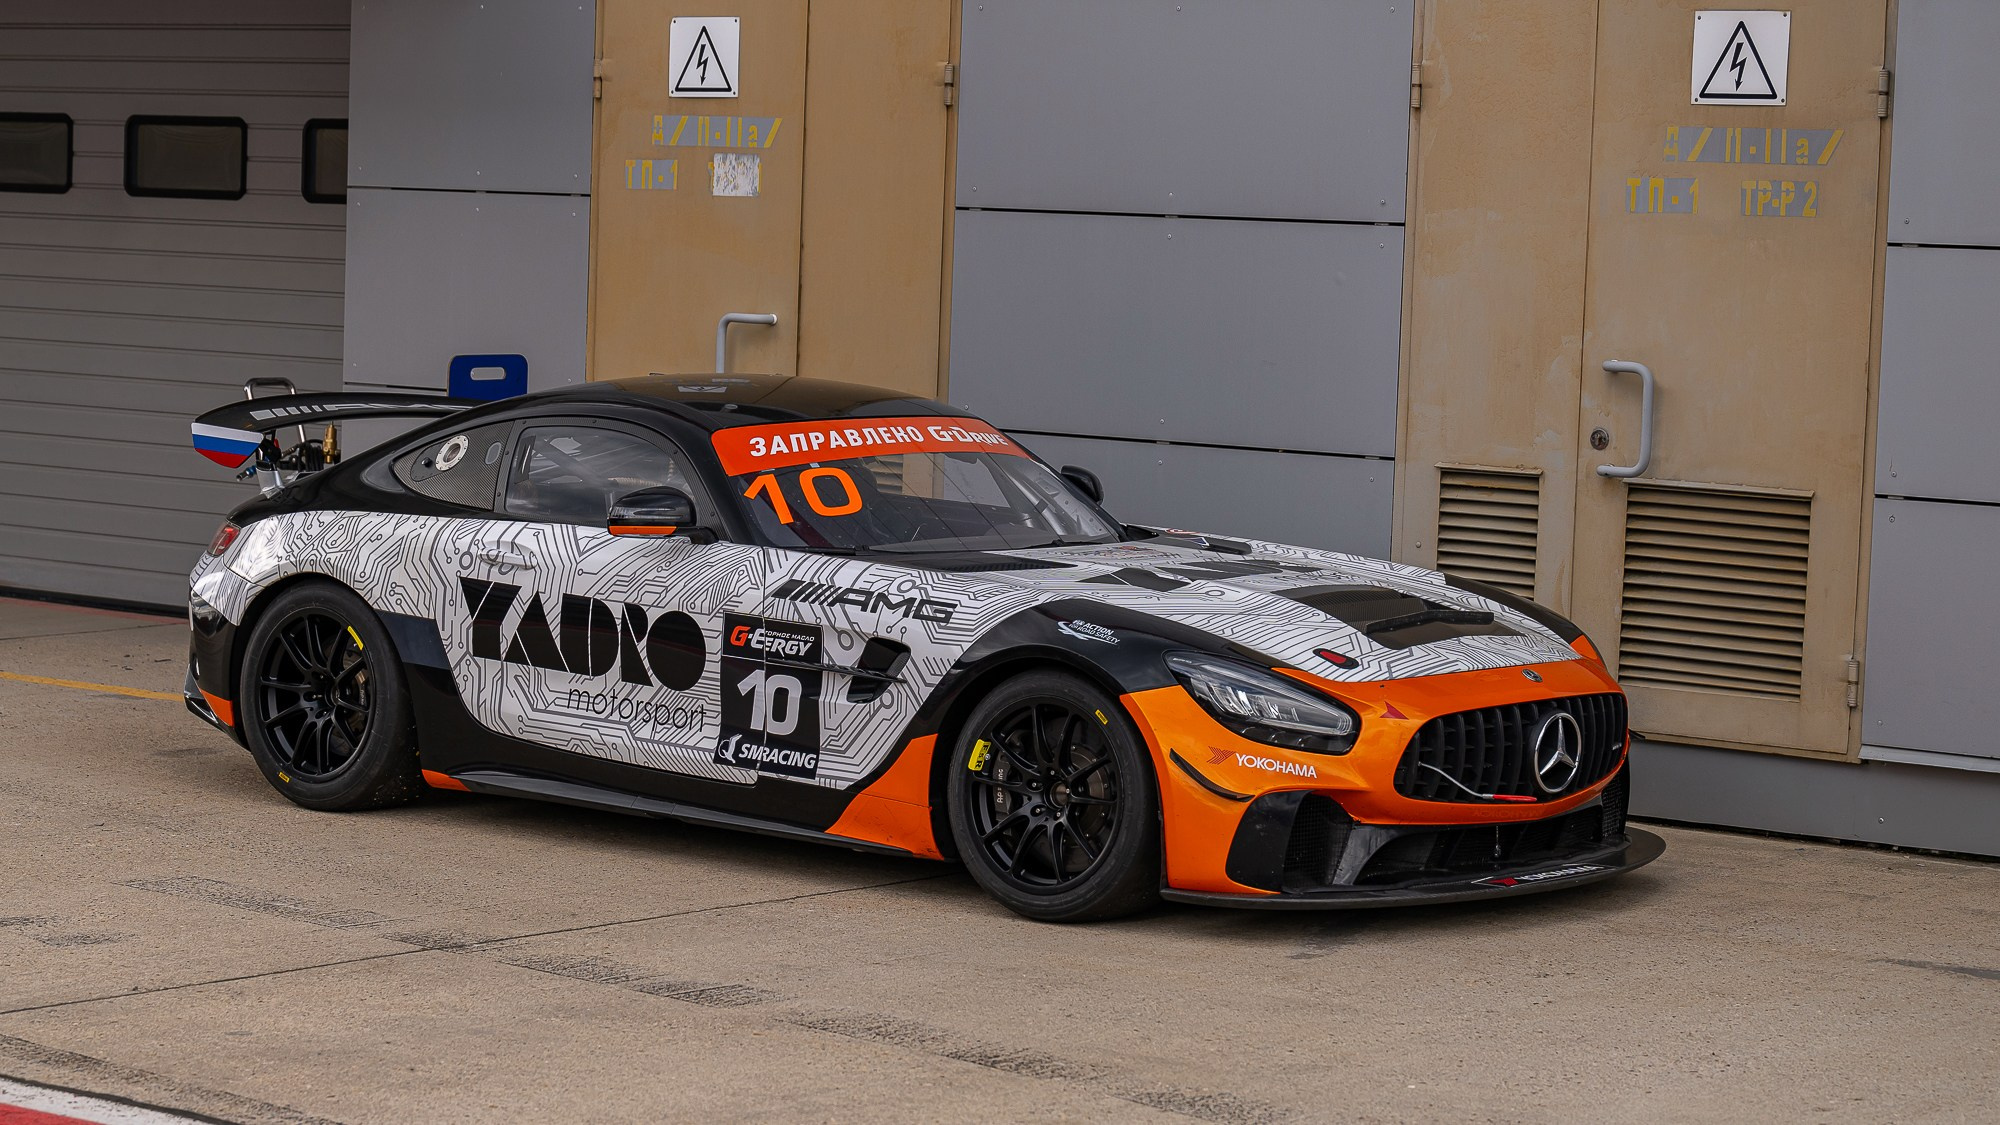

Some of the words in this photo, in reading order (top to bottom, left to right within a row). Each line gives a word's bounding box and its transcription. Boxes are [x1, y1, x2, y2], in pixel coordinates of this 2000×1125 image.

[749, 425, 925, 457] ЗАПРАВЛЕНО
[743, 467, 863, 524] 10
[459, 577, 707, 692] YADRO
[1083, 622, 1115, 636] ACTION
[1094, 631, 1121, 644] SAFETY
[567, 688, 707, 733] motorsport
[737, 669, 803, 736] 10
[1235, 752, 1318, 779] YOKOHAMA
